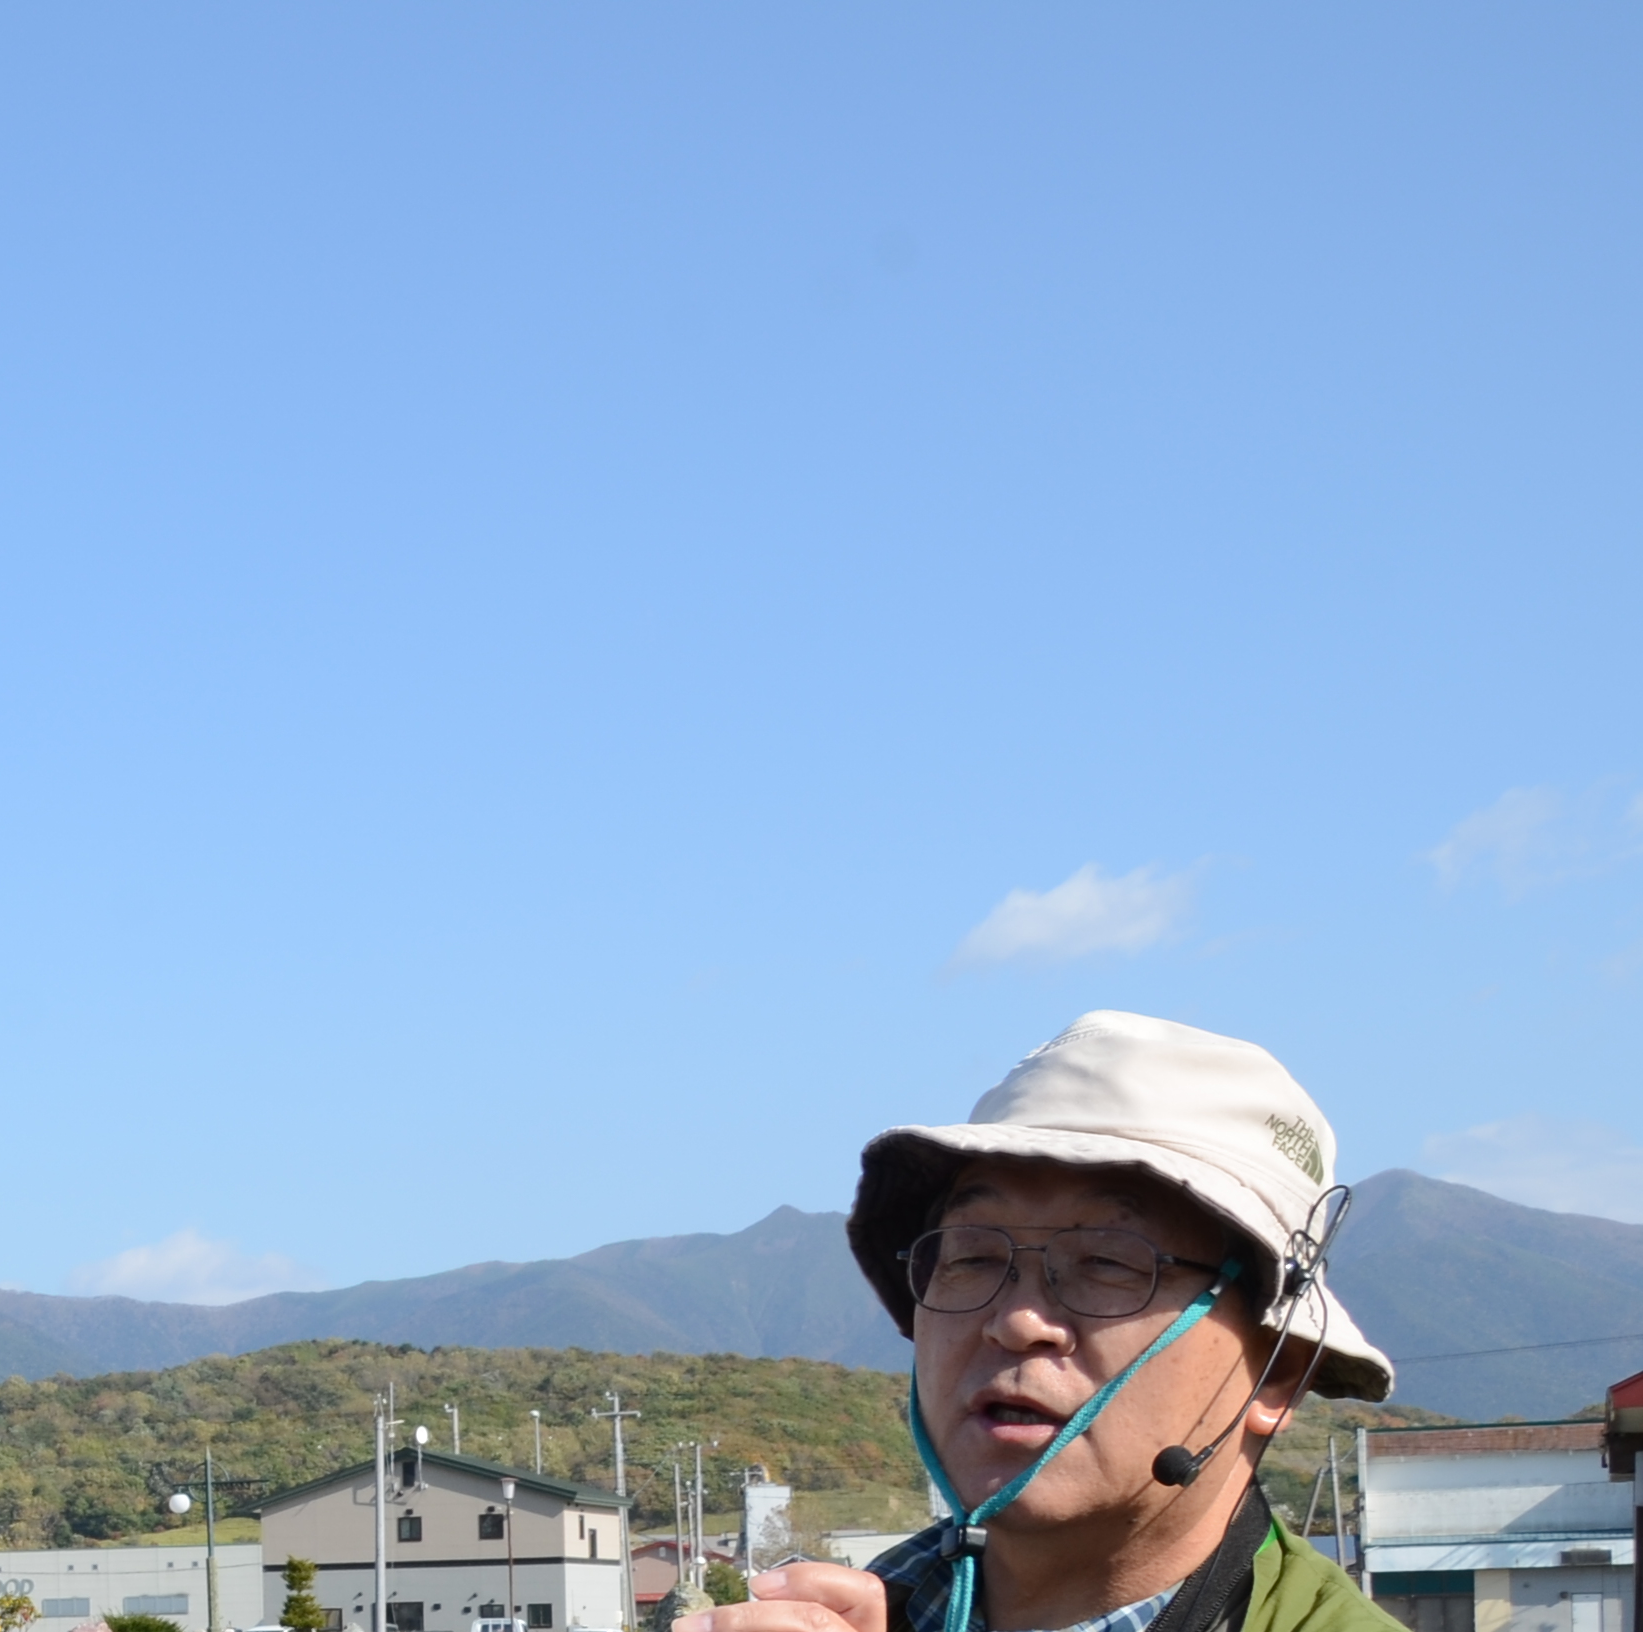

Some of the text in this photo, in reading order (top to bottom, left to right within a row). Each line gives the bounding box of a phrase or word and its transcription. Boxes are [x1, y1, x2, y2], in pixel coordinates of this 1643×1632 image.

[1265, 1113, 1312, 1157] NORTH
[1293, 1115, 1315, 1143] THE
[1272, 1136, 1305, 1168] FACE
